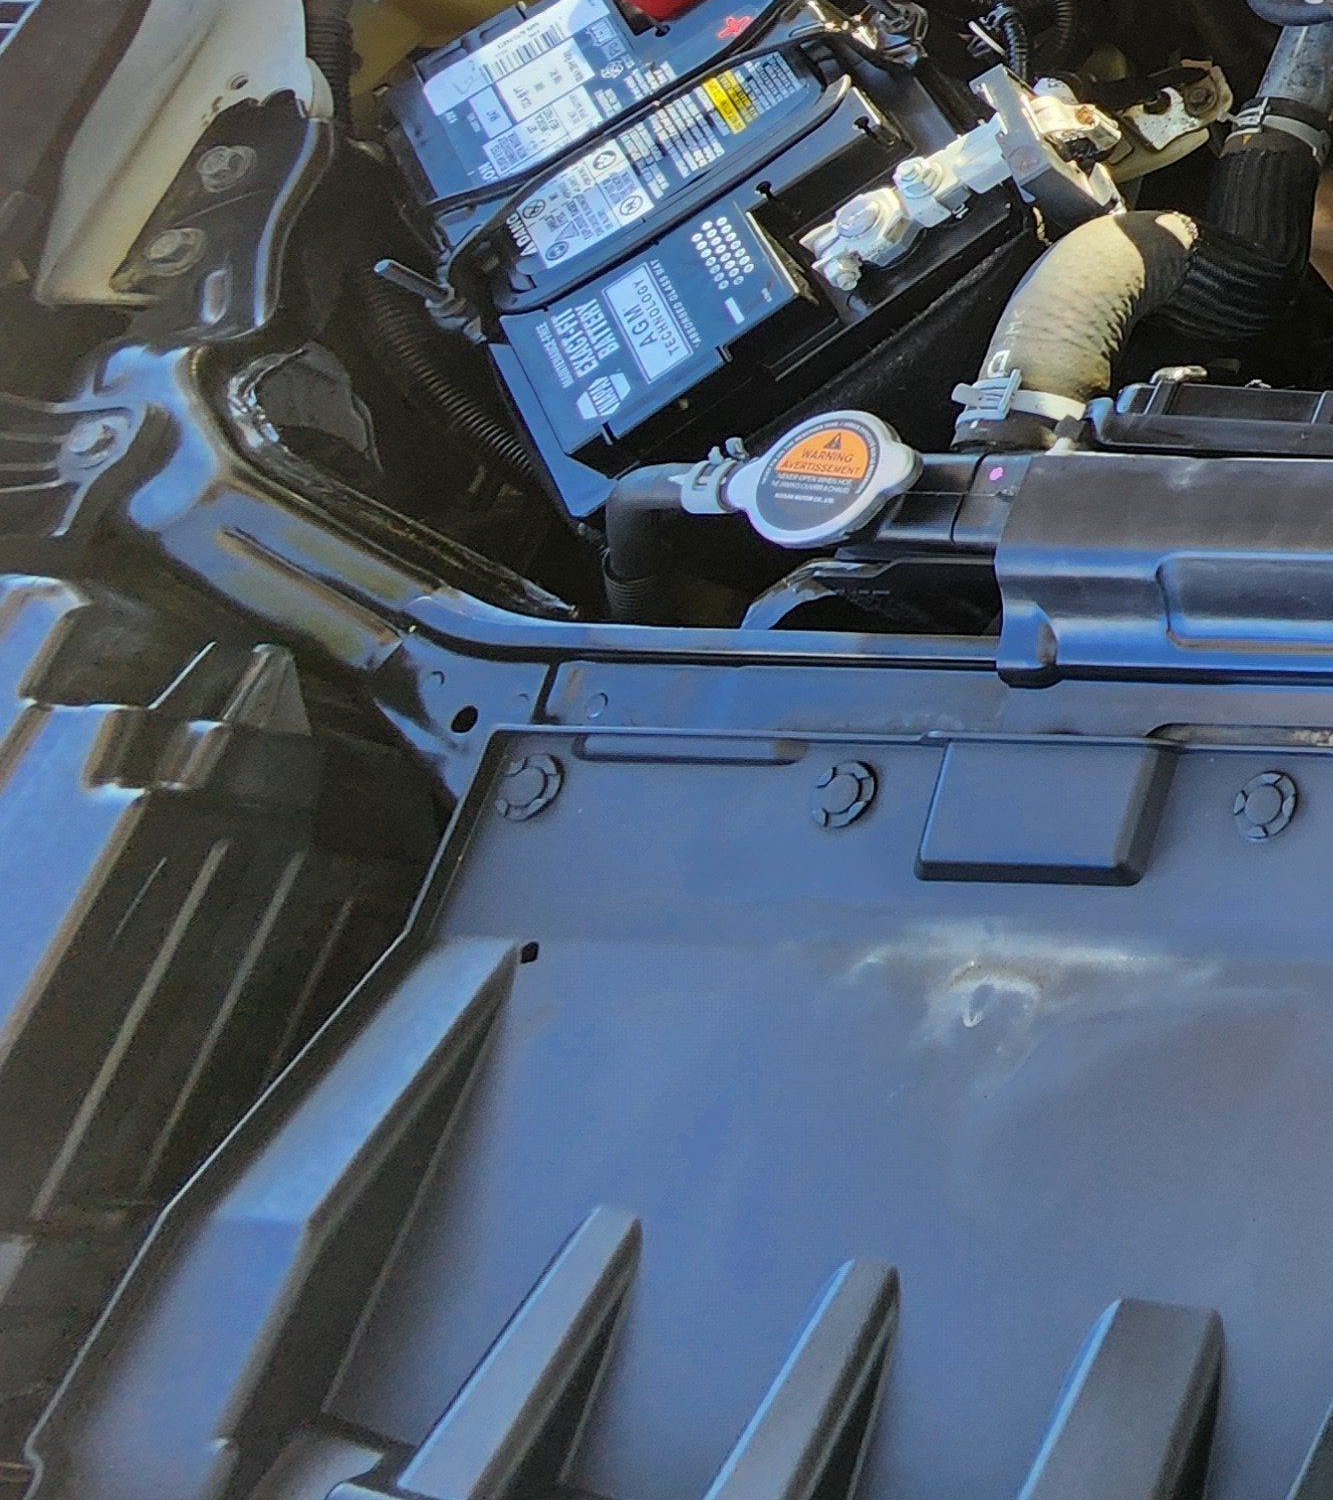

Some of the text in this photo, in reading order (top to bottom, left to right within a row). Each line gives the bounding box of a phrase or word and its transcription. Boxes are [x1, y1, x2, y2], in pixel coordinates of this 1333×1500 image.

[503, 211, 531, 247] DANG
[574, 298, 620, 360] BATTERY
[623, 306, 658, 349] AGM
[633, 280, 680, 356] TECHNOLOGY
[550, 308, 600, 378] EXACT-FIT
[781, 458, 861, 475] AVERTISSEMENT
[802, 449, 854, 463] WARNING
